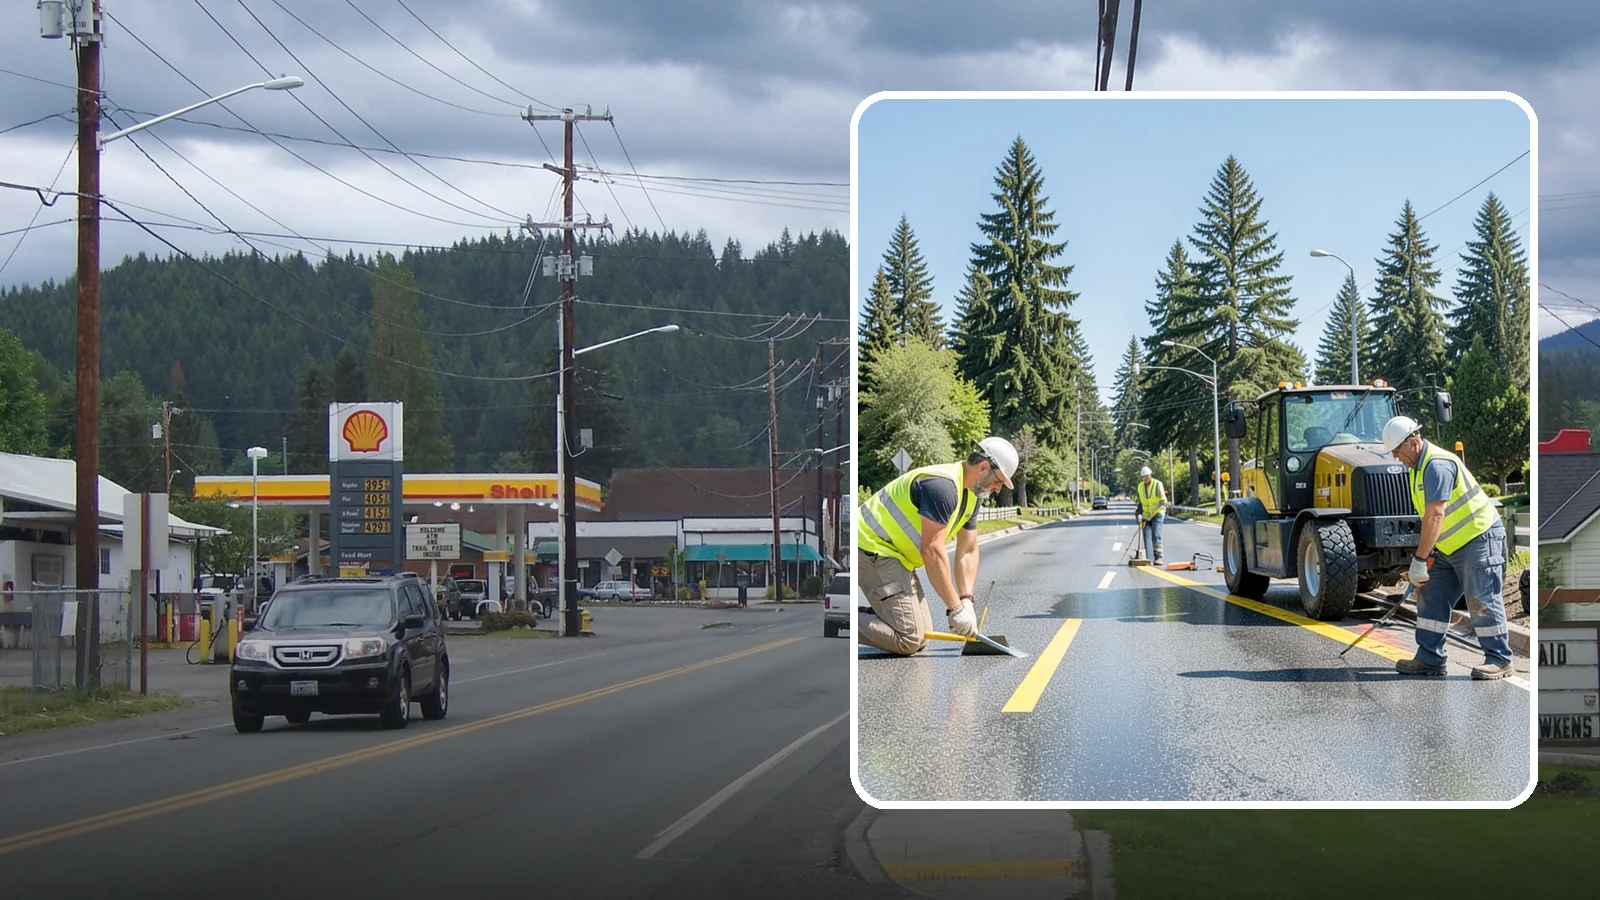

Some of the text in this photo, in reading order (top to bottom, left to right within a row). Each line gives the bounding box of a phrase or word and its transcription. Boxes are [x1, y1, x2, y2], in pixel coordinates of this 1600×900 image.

[366, 480, 384, 490] 395
[490, 484, 548, 499] Shell
[366, 494, 384, 504] 405
[366, 508, 384, 518] 415
[366, 522, 384, 533] 429
[1538, 642, 1567, 666] AID
